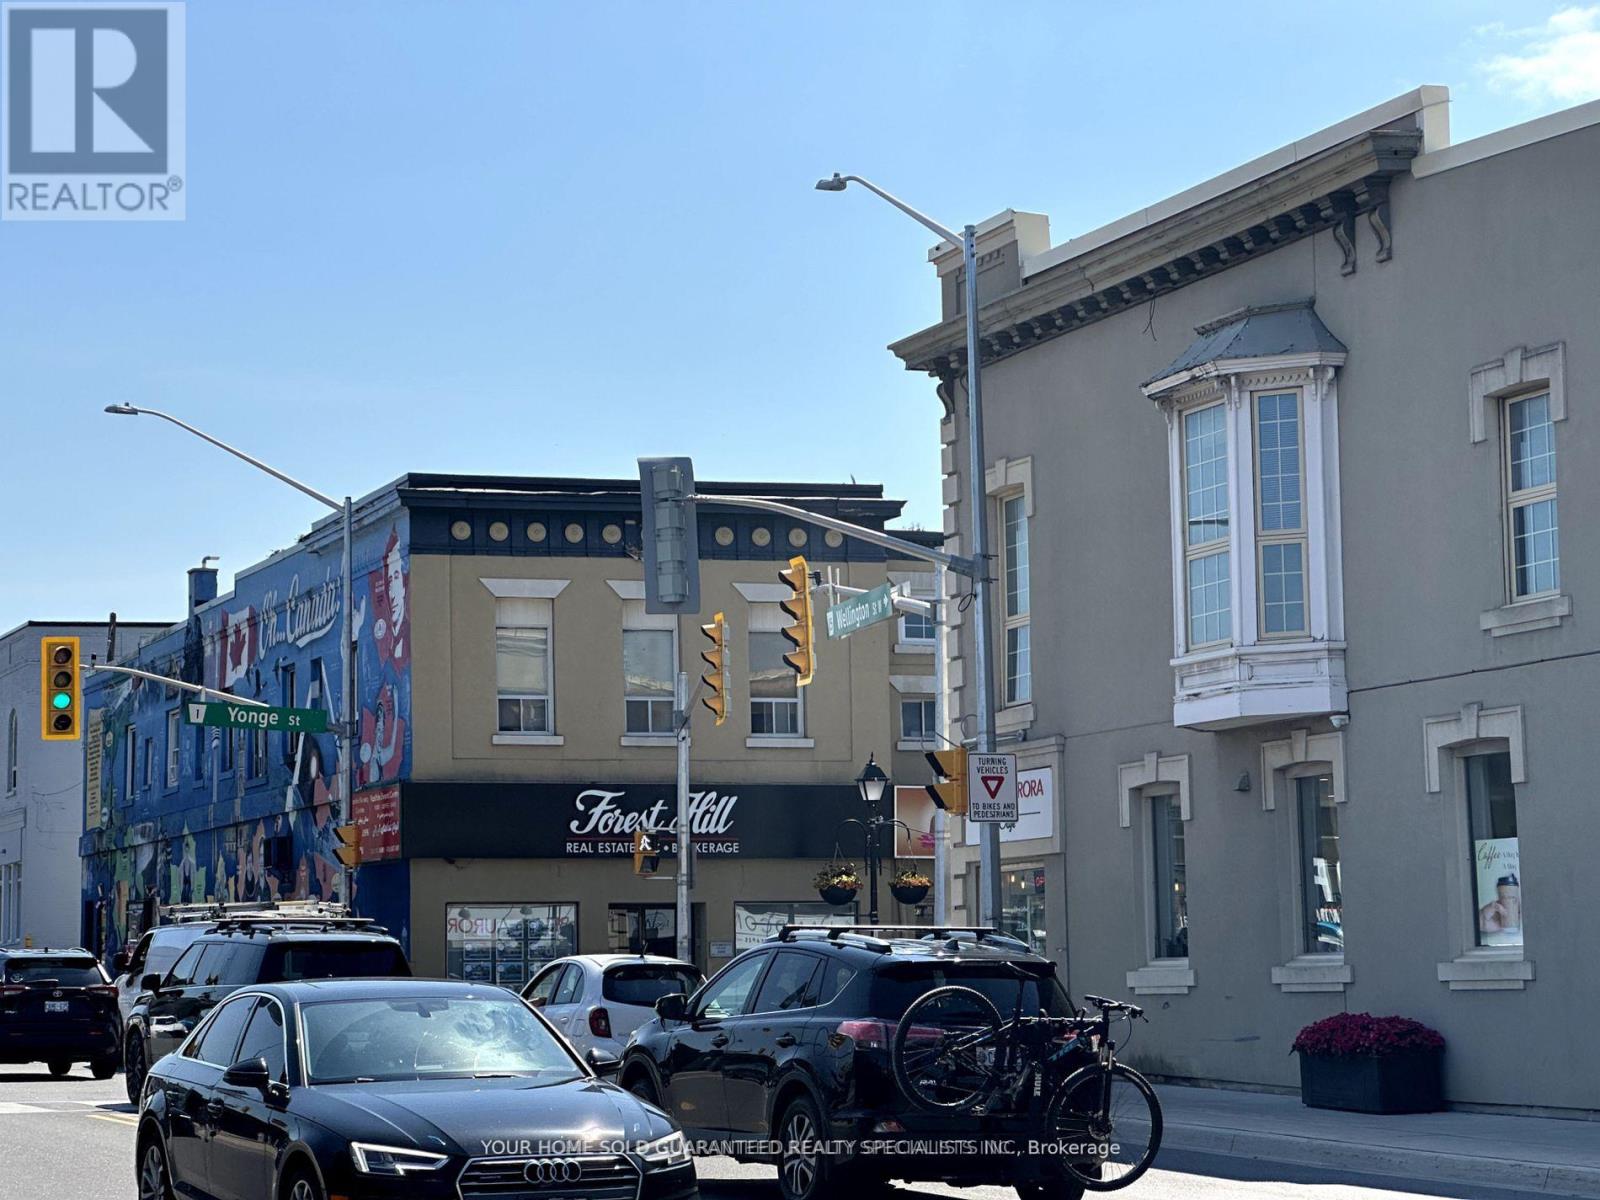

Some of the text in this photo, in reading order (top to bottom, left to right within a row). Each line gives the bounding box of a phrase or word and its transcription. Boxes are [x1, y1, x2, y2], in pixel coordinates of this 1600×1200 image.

[836, 602, 870, 630] Wellington
[228, 706, 301, 728] Yonge St
[978, 757, 1007, 766] TURNING
[976, 766, 1009, 775] VEHICLES
[1018, 778, 1044, 798] RORA
[569, 789, 668, 834] Forest
[972, 802, 1015, 811] TO BIKES AND
[973, 810, 1015, 818] PEDESTRIANS
[566, 842, 593, 853] REAL
[598, 842, 635, 853] ESTATE
[672, 842, 739, 853] BKERAGE
[1033, 1071, 1042, 1097] HULE
